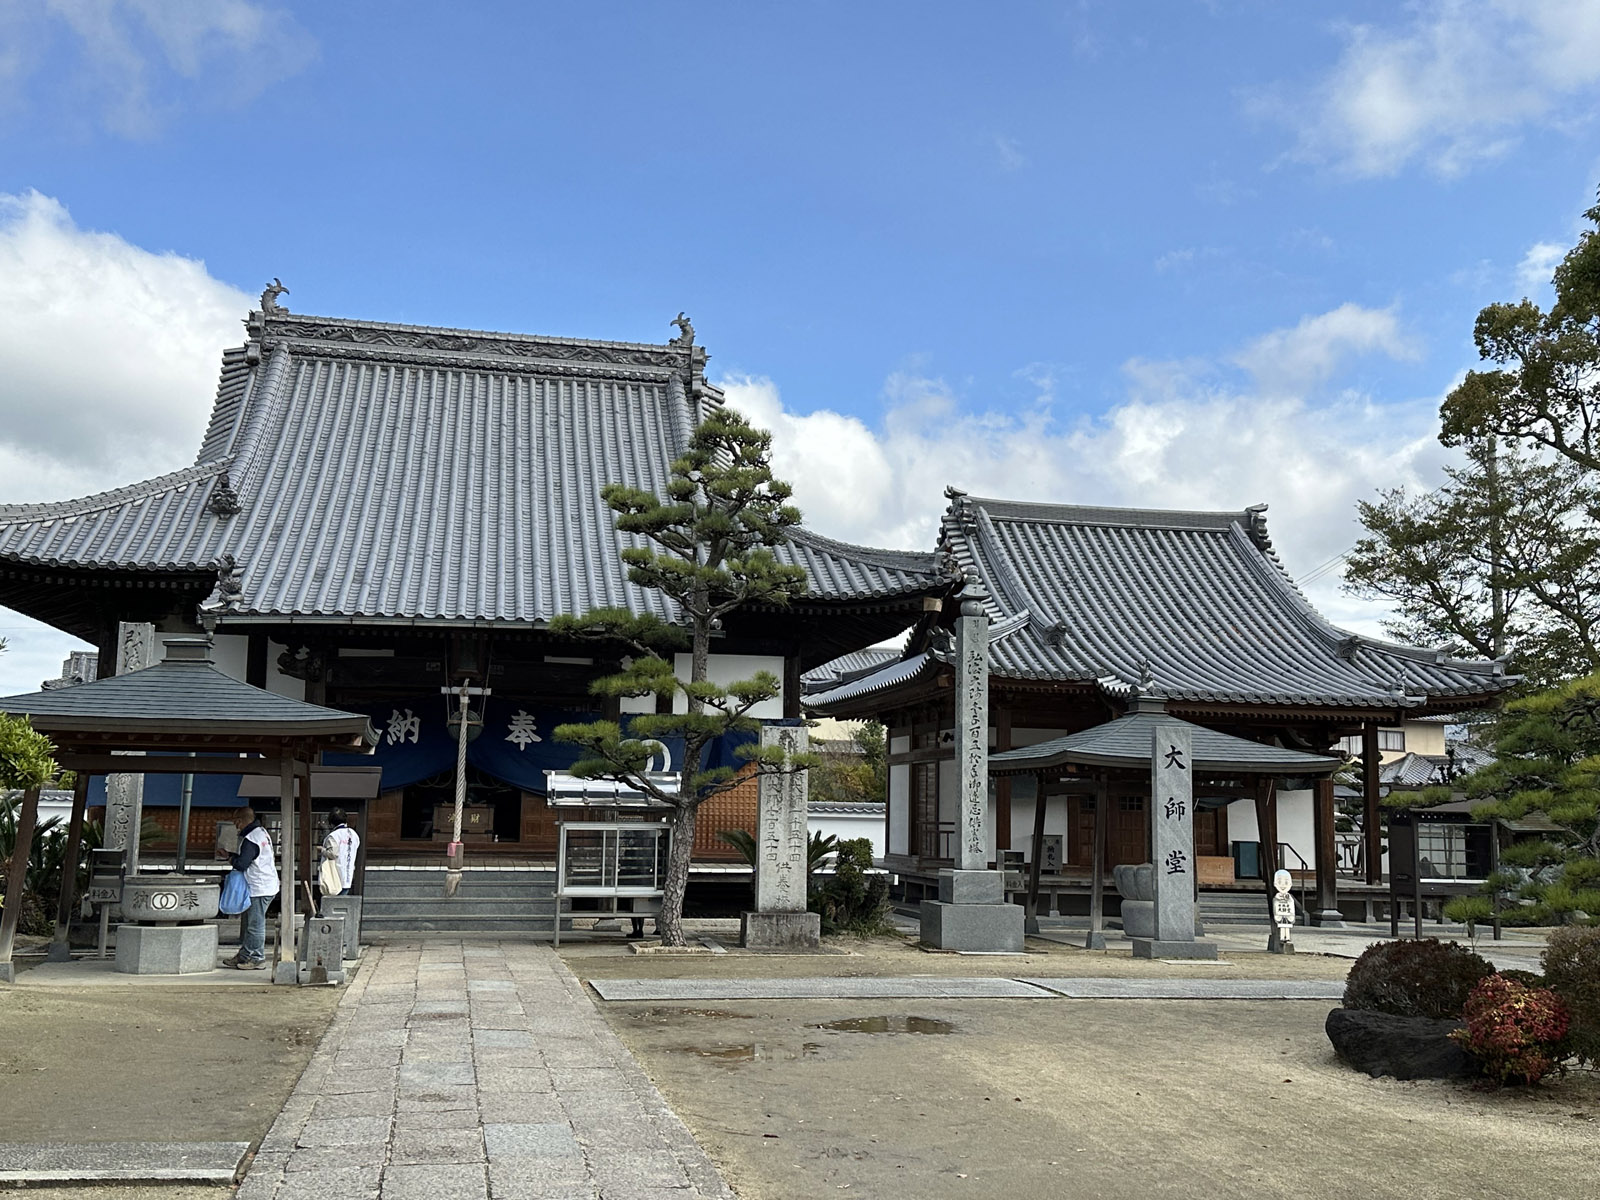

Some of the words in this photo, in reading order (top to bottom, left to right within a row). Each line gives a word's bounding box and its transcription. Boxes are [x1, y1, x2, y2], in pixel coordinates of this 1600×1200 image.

[386, 708, 421, 746] 納
[504, 709, 542, 751] 奉
[1164, 744, 1186, 875] 大師堂
[180, 890, 200, 910] 奉
